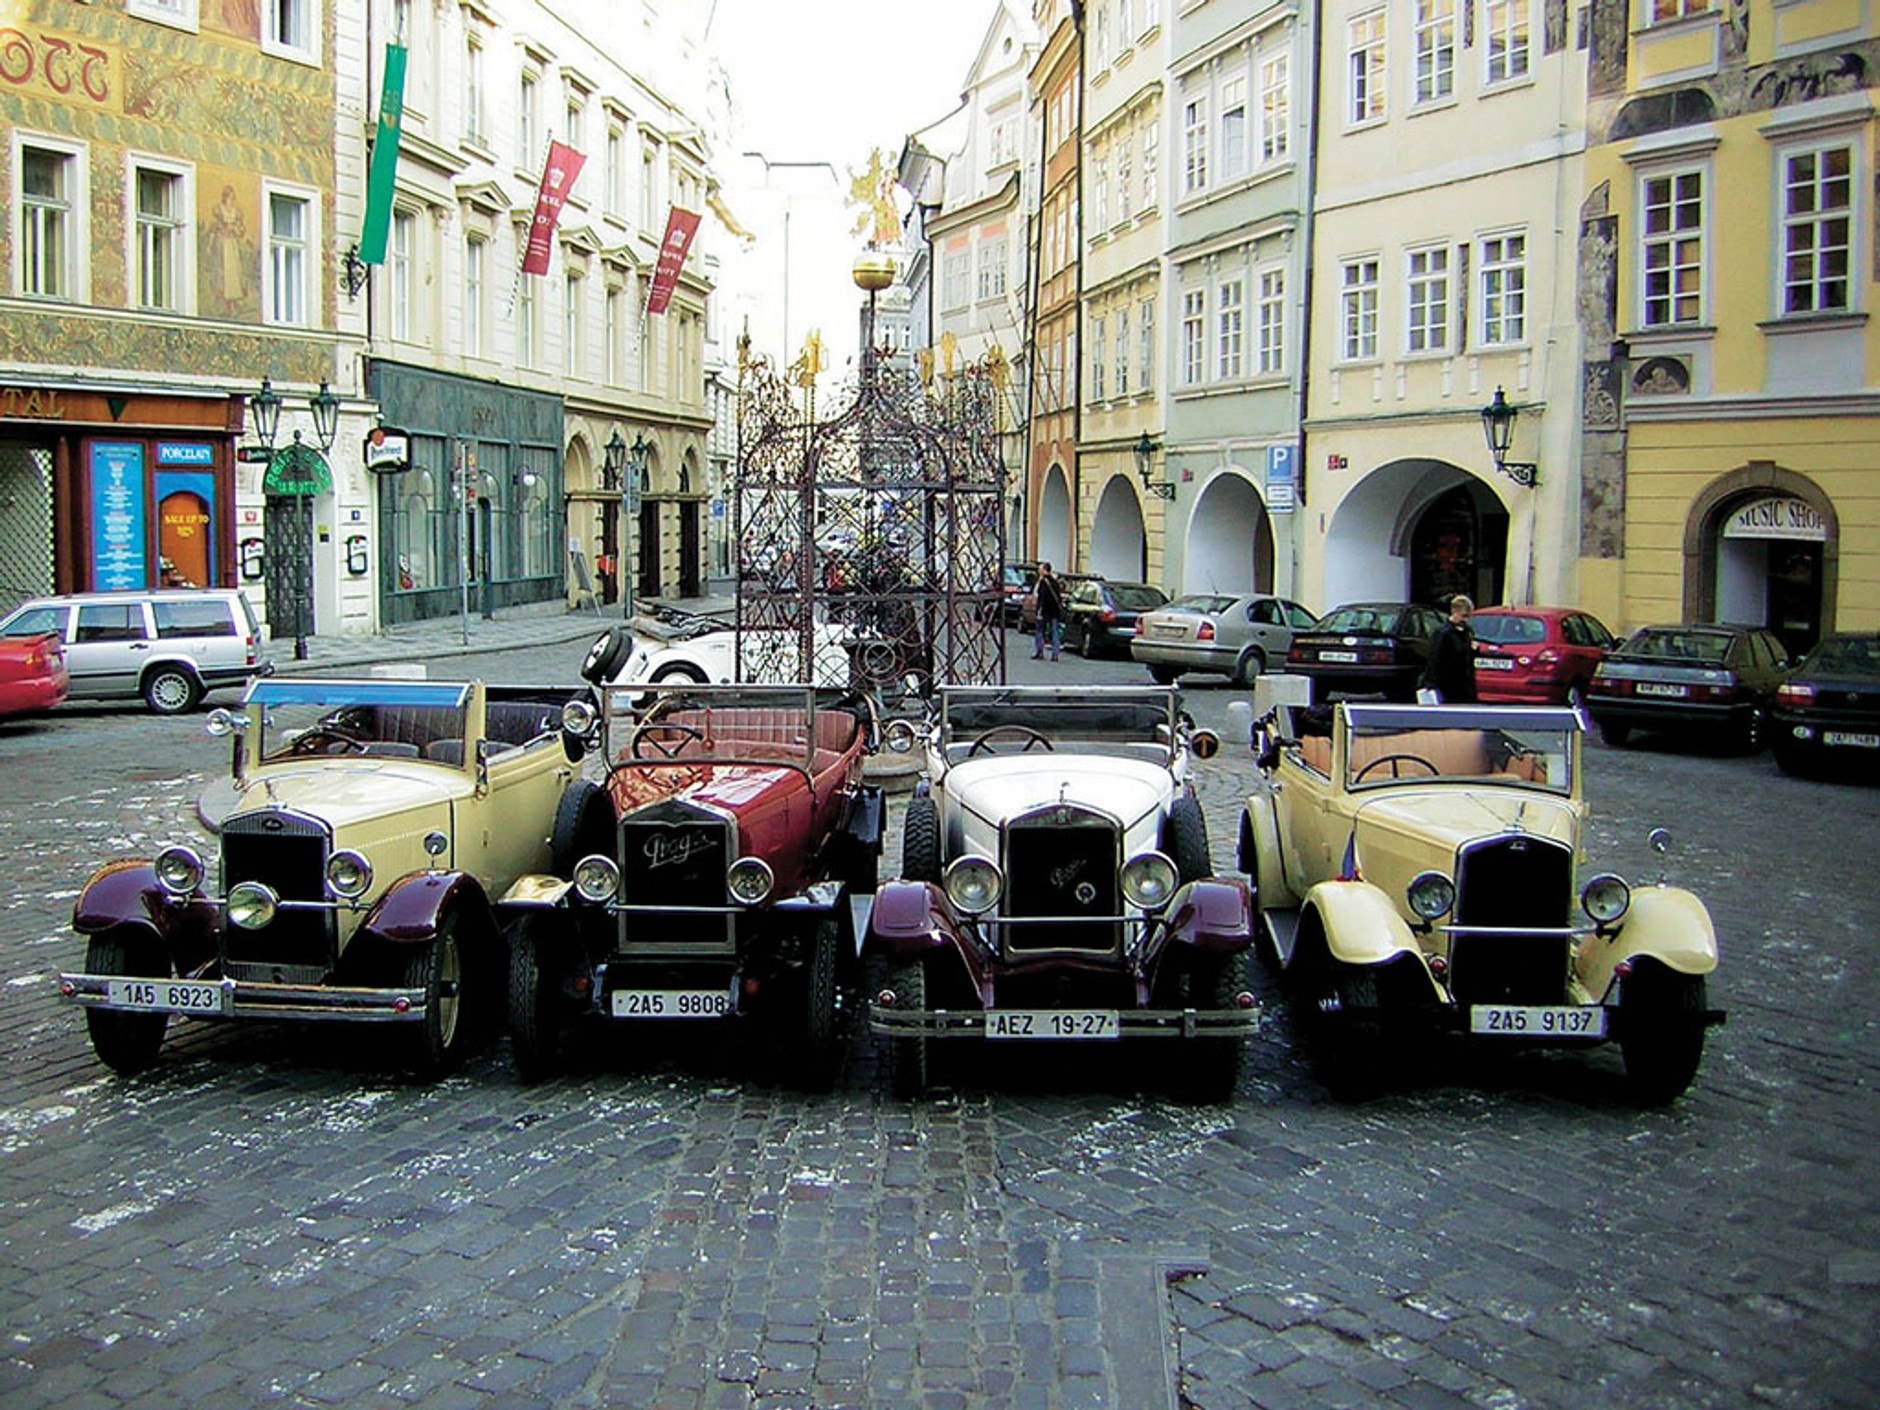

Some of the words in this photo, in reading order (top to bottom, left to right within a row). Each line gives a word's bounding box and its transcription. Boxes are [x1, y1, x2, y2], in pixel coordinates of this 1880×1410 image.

[161, 447, 211, 460] PORCELAIN
[1273, 448, 1288, 470] P
[1737, 499, 1784, 527] MUSIC
[123, 984, 155, 1004] 1A5
[168, 985, 213, 1008] 6923
[628, 994, 664, 1014] 2A5
[678, 994, 726, 1014] 9808
[996, 1015, 1034, 1035] AEZ
[1051, 1015, 1108, 1035] 19-27
[1488, 1010, 1527, 1030] 2A5
[1542, 1011, 1593, 1032] 9137
